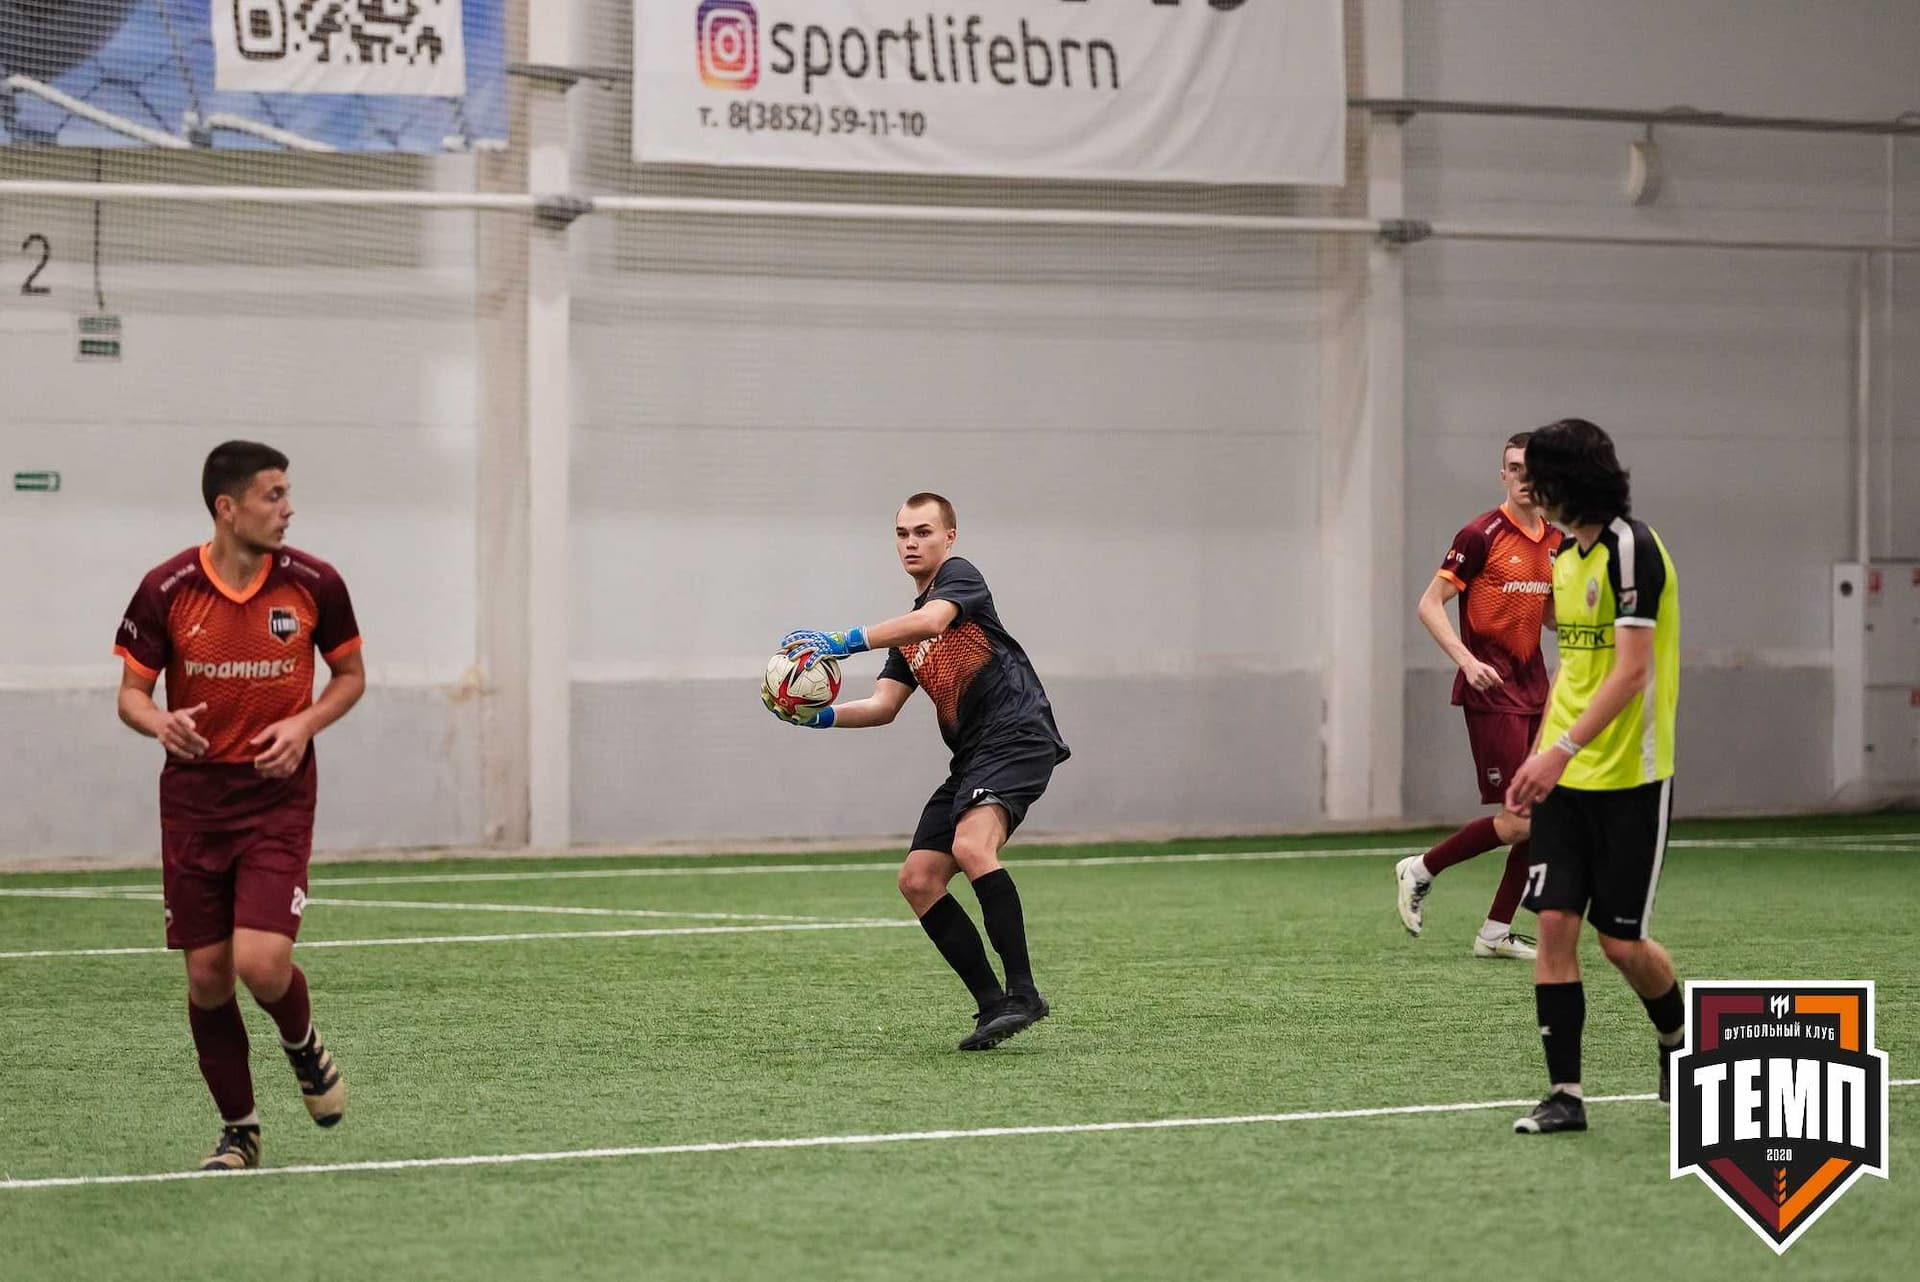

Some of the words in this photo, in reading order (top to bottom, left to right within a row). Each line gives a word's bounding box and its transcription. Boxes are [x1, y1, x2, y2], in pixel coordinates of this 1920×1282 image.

[769, 13, 1119, 94] sportlifebrn
[729, 100, 822, 135] 8(3852)
[830, 106, 925, 136] 59-11-10
[22, 233, 51, 295] 2
